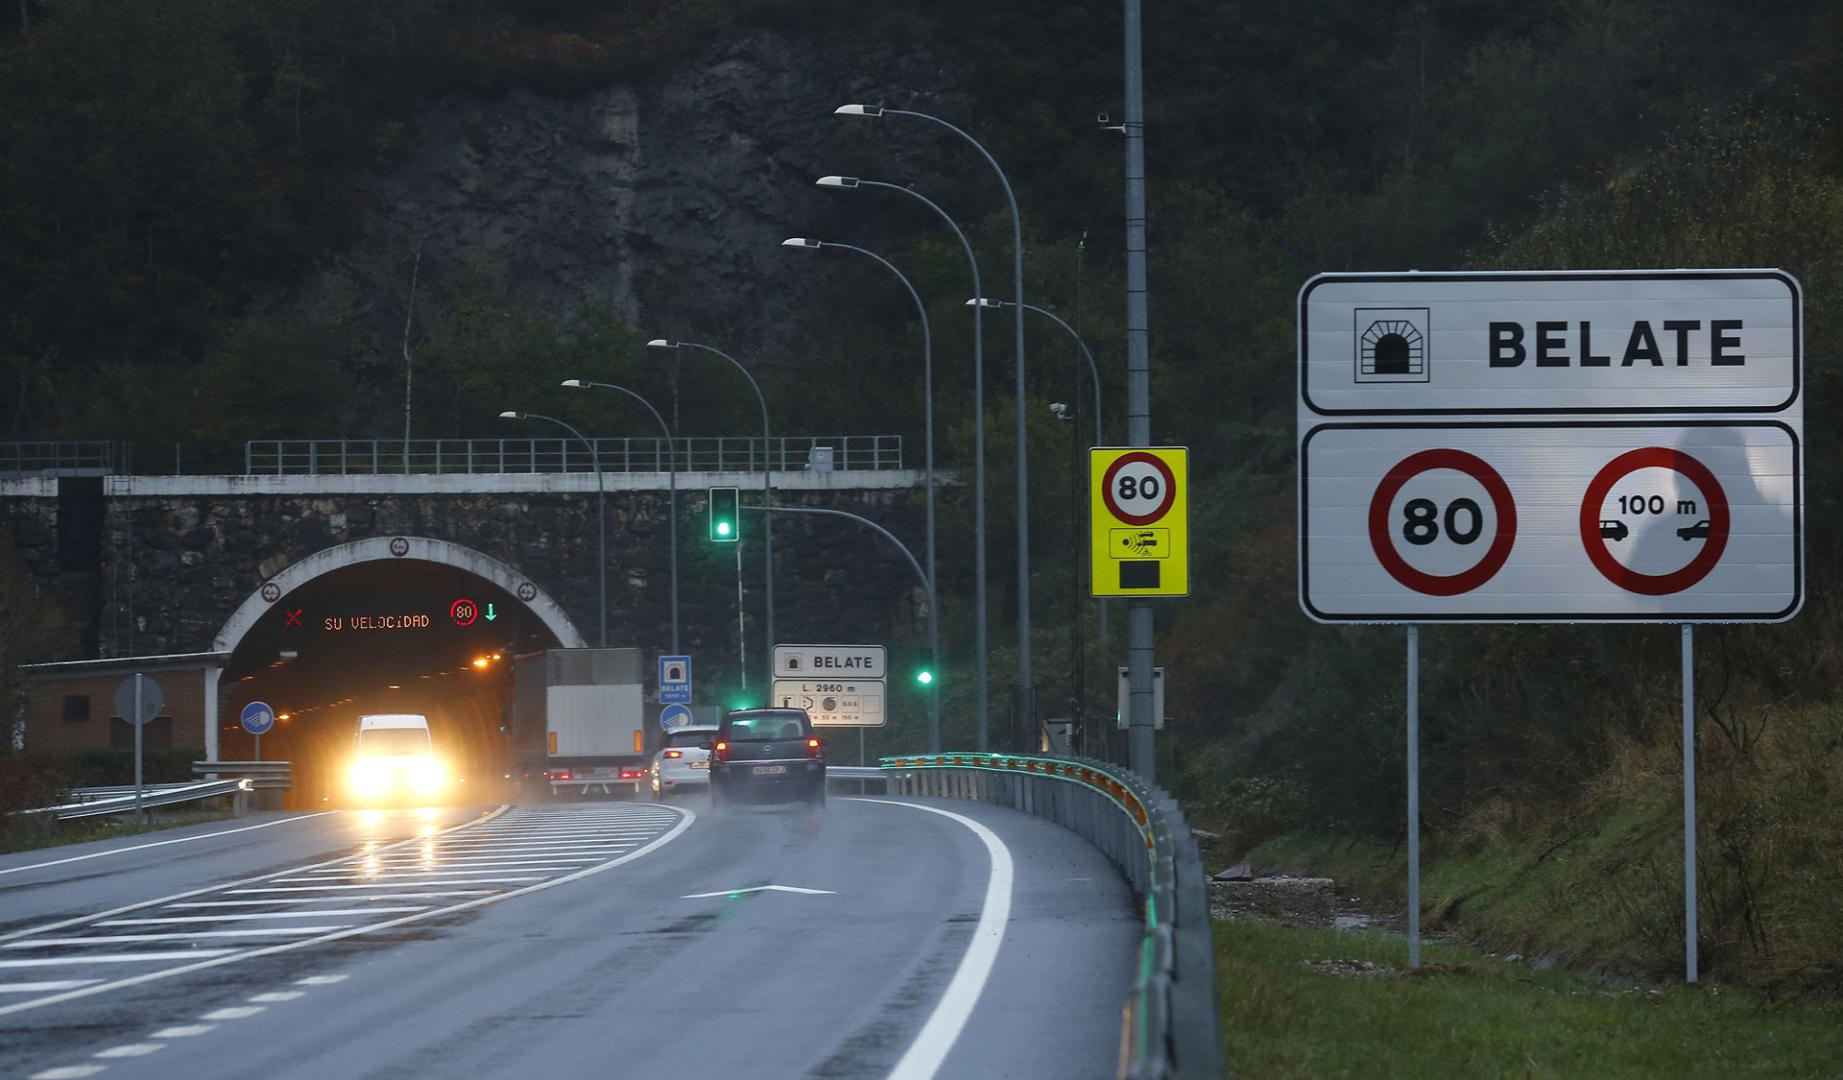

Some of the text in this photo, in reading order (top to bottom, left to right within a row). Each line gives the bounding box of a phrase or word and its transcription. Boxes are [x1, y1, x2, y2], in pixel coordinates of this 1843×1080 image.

[1489, 319, 1746, 368] BELATE
[1118, 475, 1160, 500] 80
[1618, 494, 1697, 515] 100 m
[1402, 497, 1484, 545] 80
[456, 606, 473, 619] 80
[324, 617, 342, 631] SU
[814, 656, 873, 668] BELATE
[802, 684, 812, 692] L.
[816, 684, 843, 693] 2960
